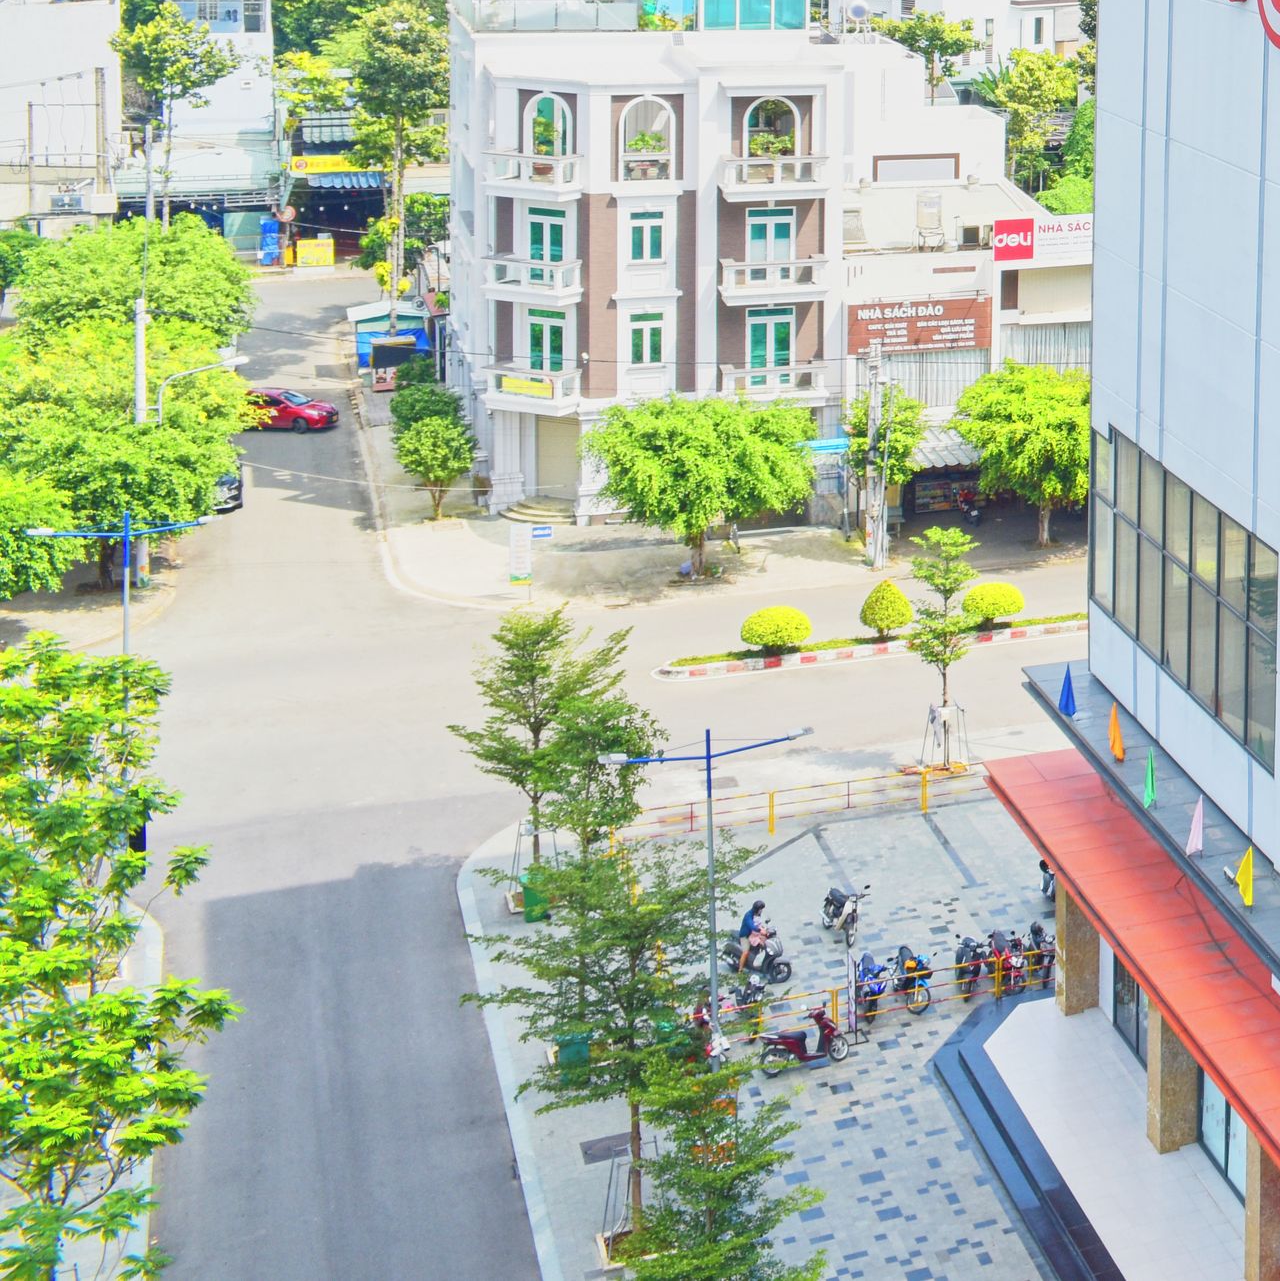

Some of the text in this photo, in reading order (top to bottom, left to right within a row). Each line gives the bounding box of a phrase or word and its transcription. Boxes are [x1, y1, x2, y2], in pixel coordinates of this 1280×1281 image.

[993, 231, 1032, 248] deli
[857, 303, 944, 320] NHÀ SÁCH ĐÀO
